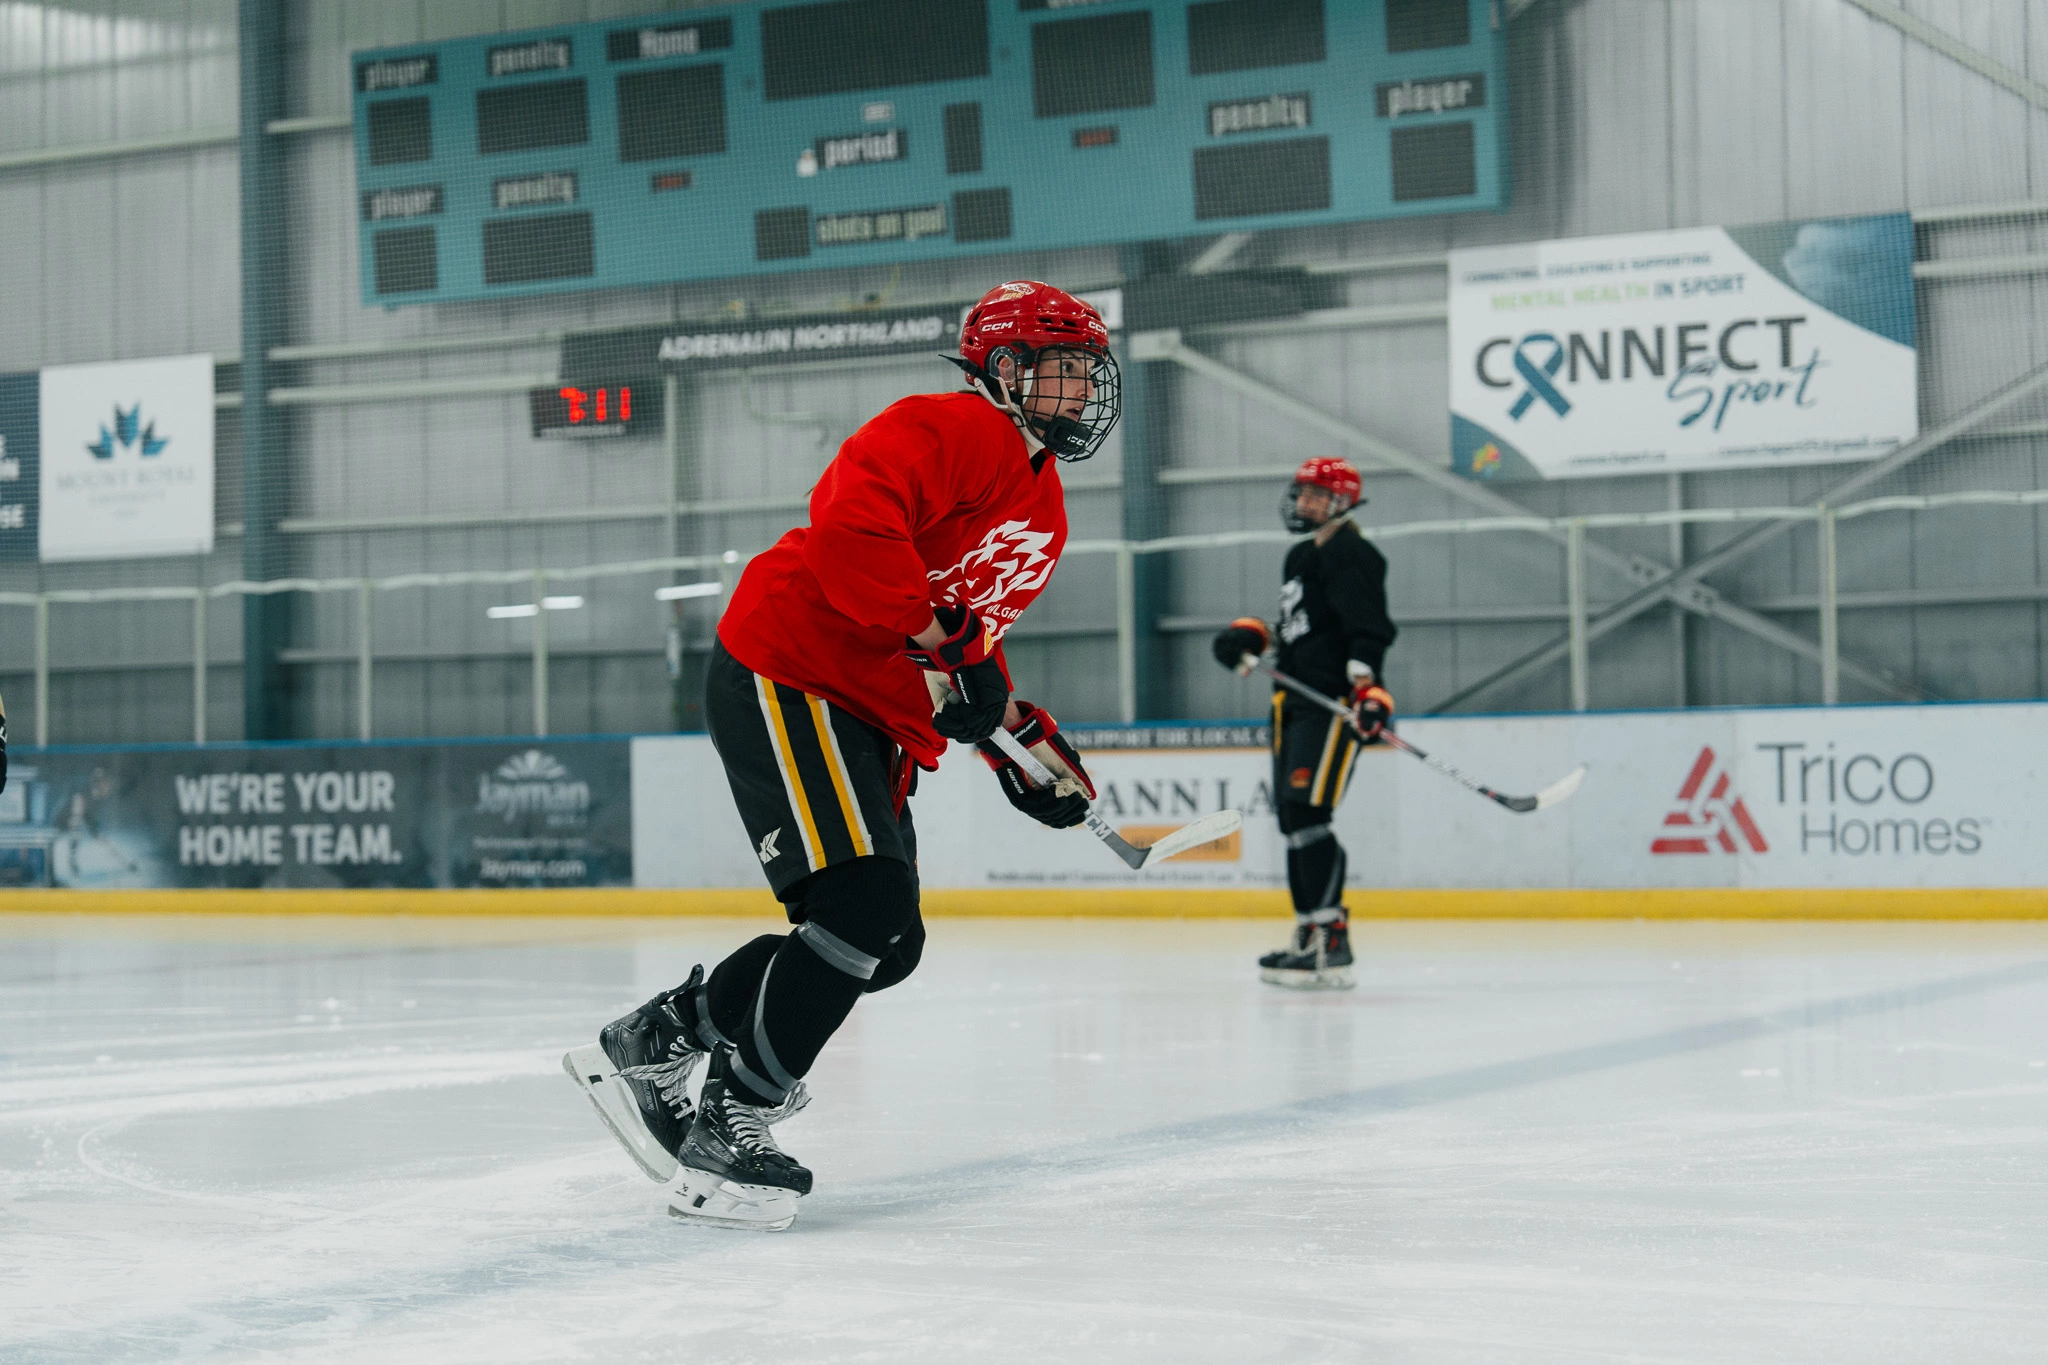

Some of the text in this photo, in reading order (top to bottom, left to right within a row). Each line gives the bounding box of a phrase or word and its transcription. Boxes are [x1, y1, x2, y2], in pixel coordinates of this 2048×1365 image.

[1212, 95, 1306, 136] penalty
[1389, 80, 1471, 119] player
[824, 129, 898, 169] period
[1573, 280, 1650, 303] HEALTH
[1653, 280, 1675, 300] IN
[1679, 273, 1746, 297] SPORT
[793, 316, 944, 350] NORTHLAND
[981, 320, 1014, 332] CCM
[1088, 320, 1107, 336] CCM
[1666, 347, 1831, 431] Sport
[174, 771, 395, 814] WE'RE YOUR
[1755, 742, 1933, 805] Trico
[477, 771, 590, 823] Jayman
[179, 823, 403, 866] HOME TEAM.
[1800, 811, 1982, 855] Homes
[481, 856, 587, 882] Jayman.com
